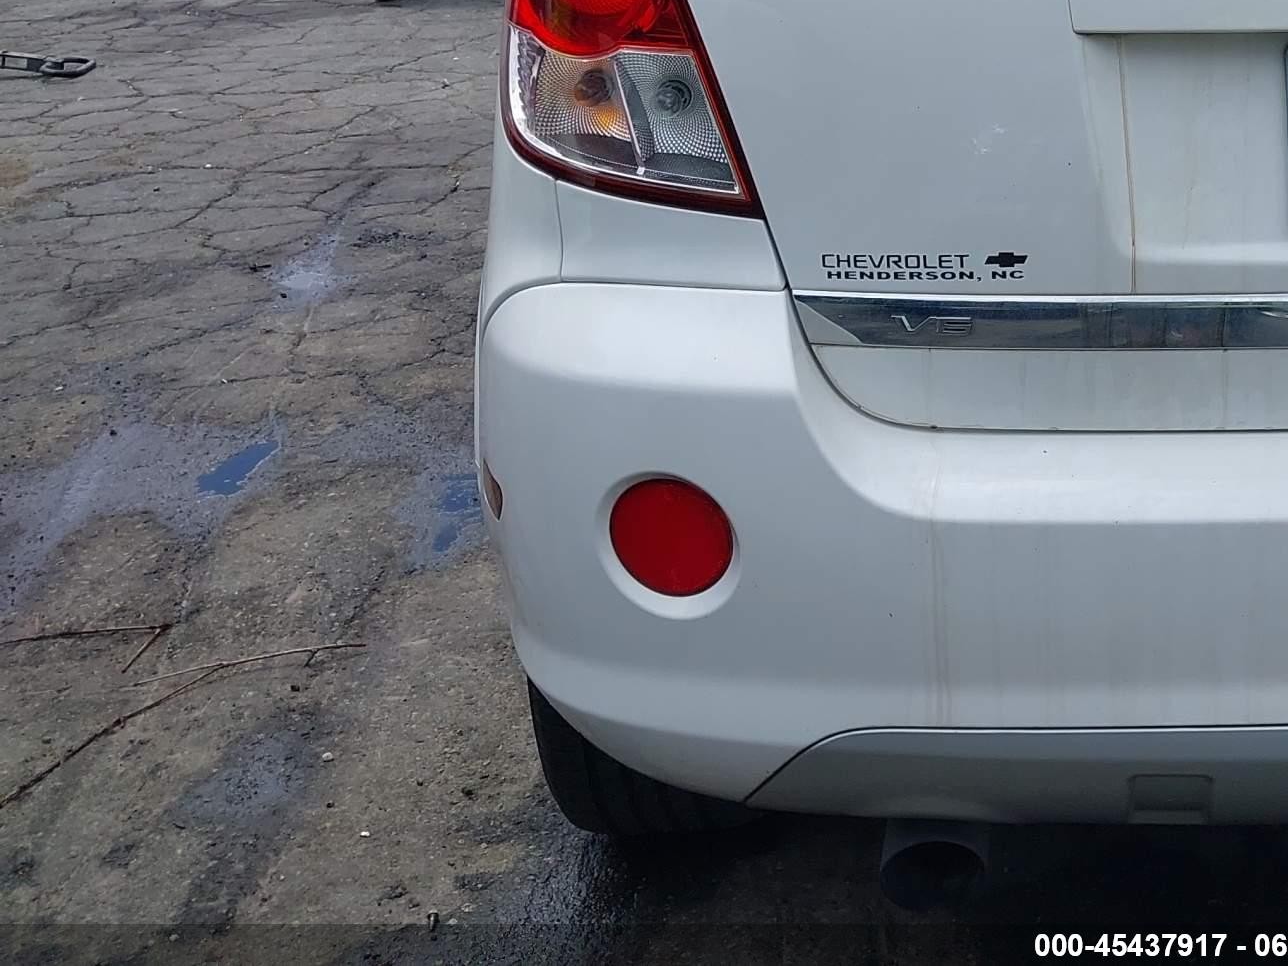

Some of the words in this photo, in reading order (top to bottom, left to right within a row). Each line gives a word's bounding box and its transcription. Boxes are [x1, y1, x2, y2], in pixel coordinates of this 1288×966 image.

[821, 254, 970, 269] CHEVROLET
[827, 270, 982, 282] HENDERSON,
[991, 270, 1025, 280] NC
[890, 315, 973, 336] V6
